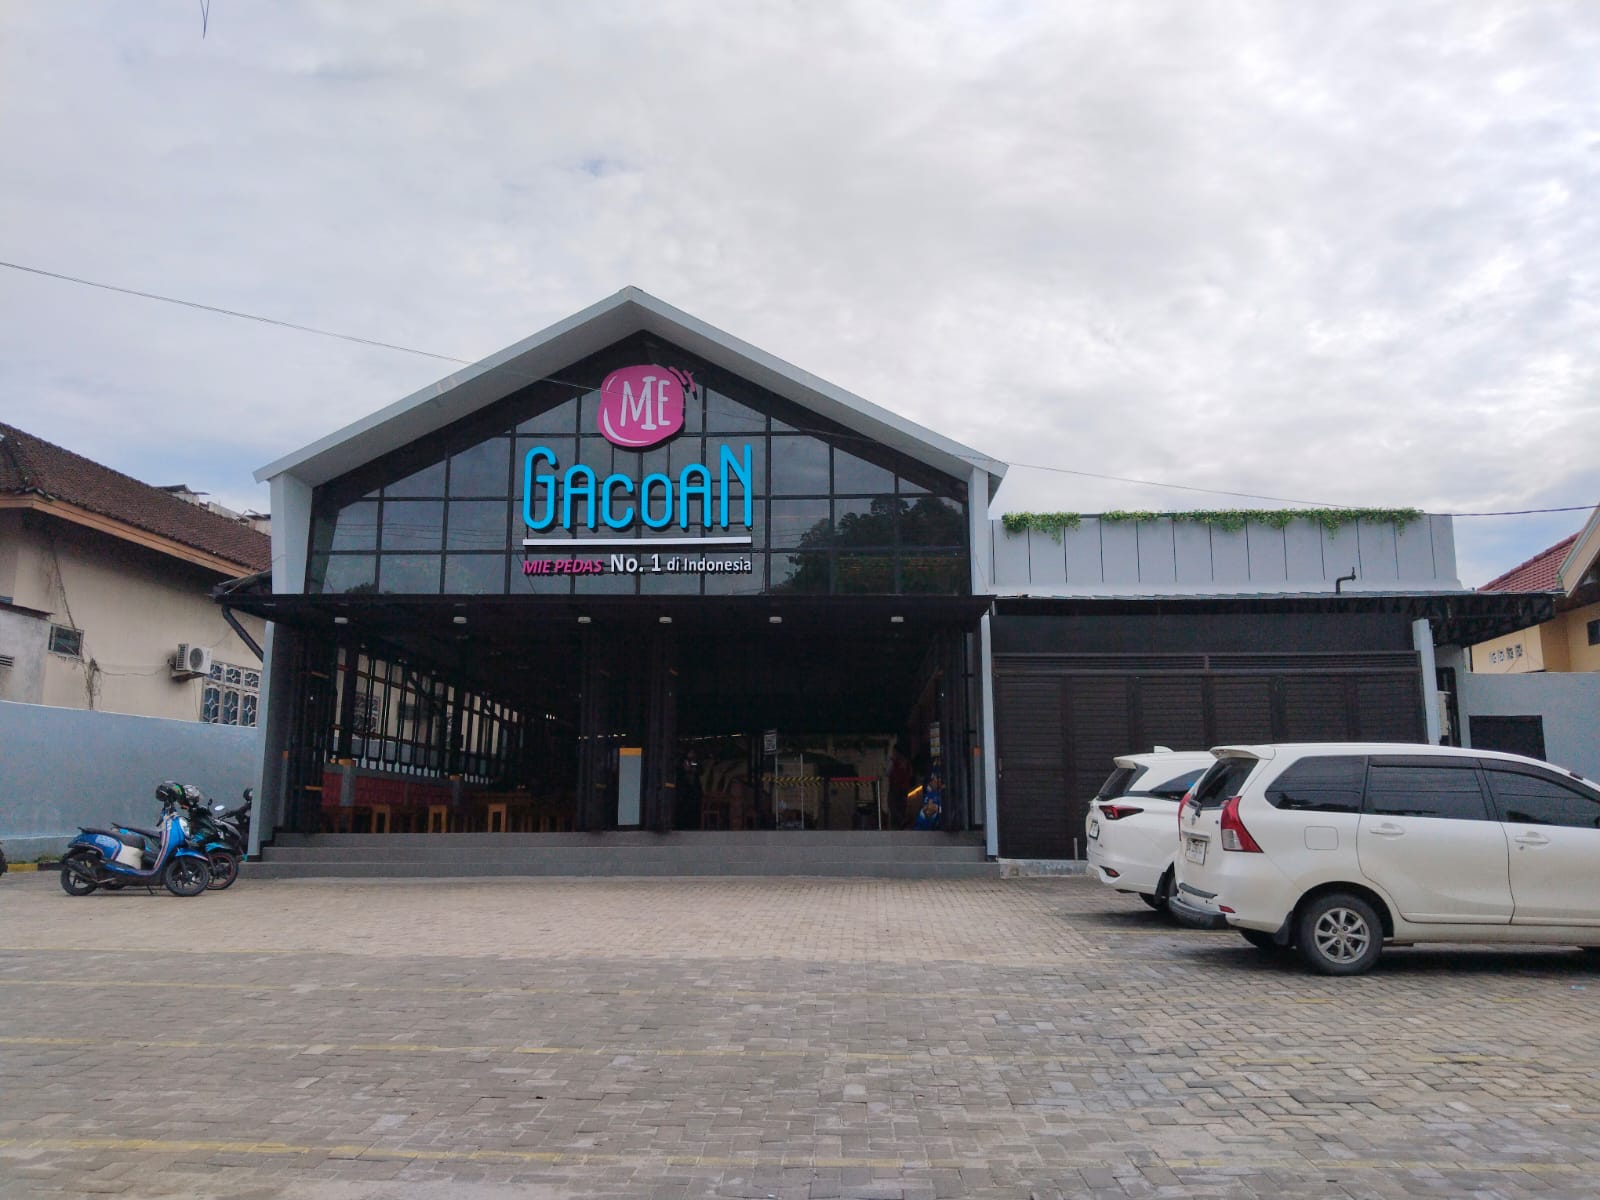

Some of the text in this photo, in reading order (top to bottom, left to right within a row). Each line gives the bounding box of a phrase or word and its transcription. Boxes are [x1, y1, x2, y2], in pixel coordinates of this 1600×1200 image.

[620, 376, 671, 430] MIE
[522, 553, 752, 574] MIE PEDAS No. 1 di Indonesia
